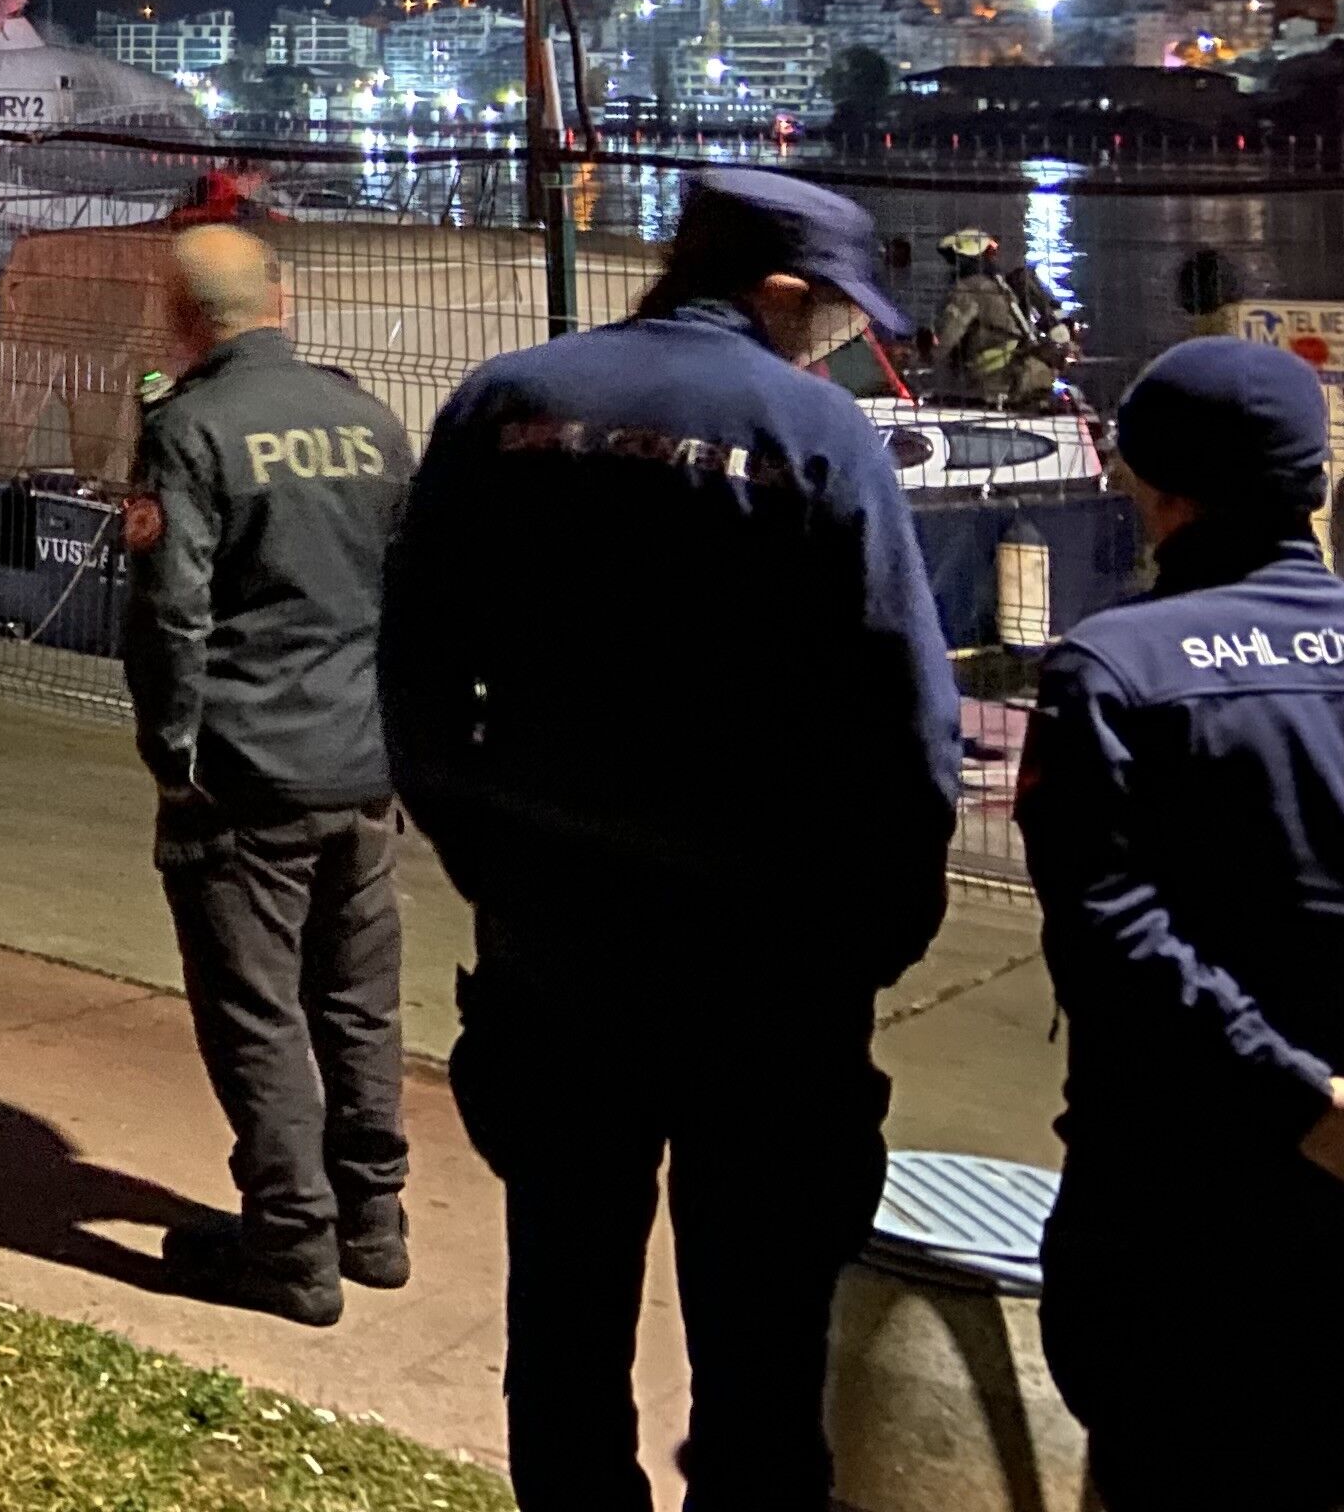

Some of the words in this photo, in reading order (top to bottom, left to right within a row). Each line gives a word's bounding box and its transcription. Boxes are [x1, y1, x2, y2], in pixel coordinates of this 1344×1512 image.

[33, 96, 45, 118] 2
[245, 425, 385, 484] POLİS
[1181, 626, 1290, 669] SAHİL
[1293, 626, 1344, 665] GÜ
